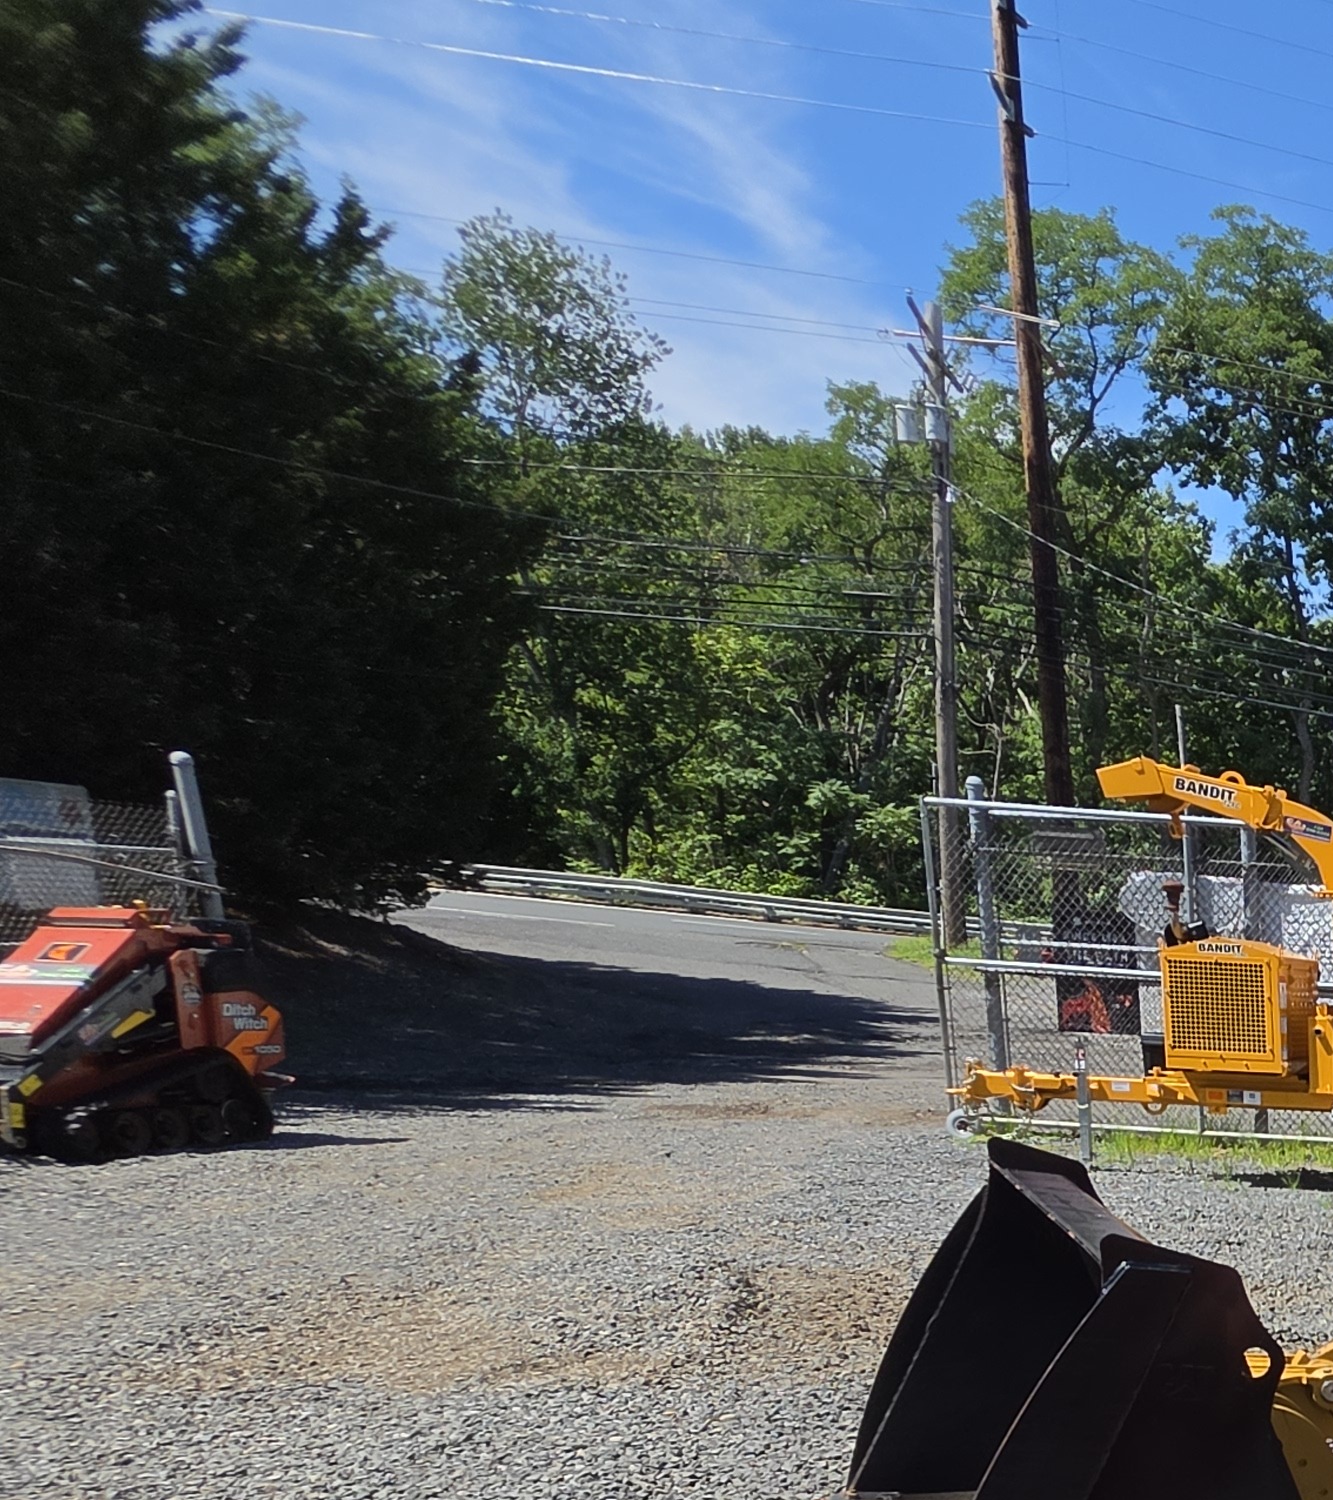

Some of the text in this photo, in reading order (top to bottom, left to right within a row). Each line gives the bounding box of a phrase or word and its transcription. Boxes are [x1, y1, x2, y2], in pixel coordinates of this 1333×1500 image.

[1174, 777, 1236, 801] BANDIT
[1198, 943, 1242, 954] BANDIT
[222, 1003, 256, 1016] Ditch
[233, 1017, 267, 1030] Witch
